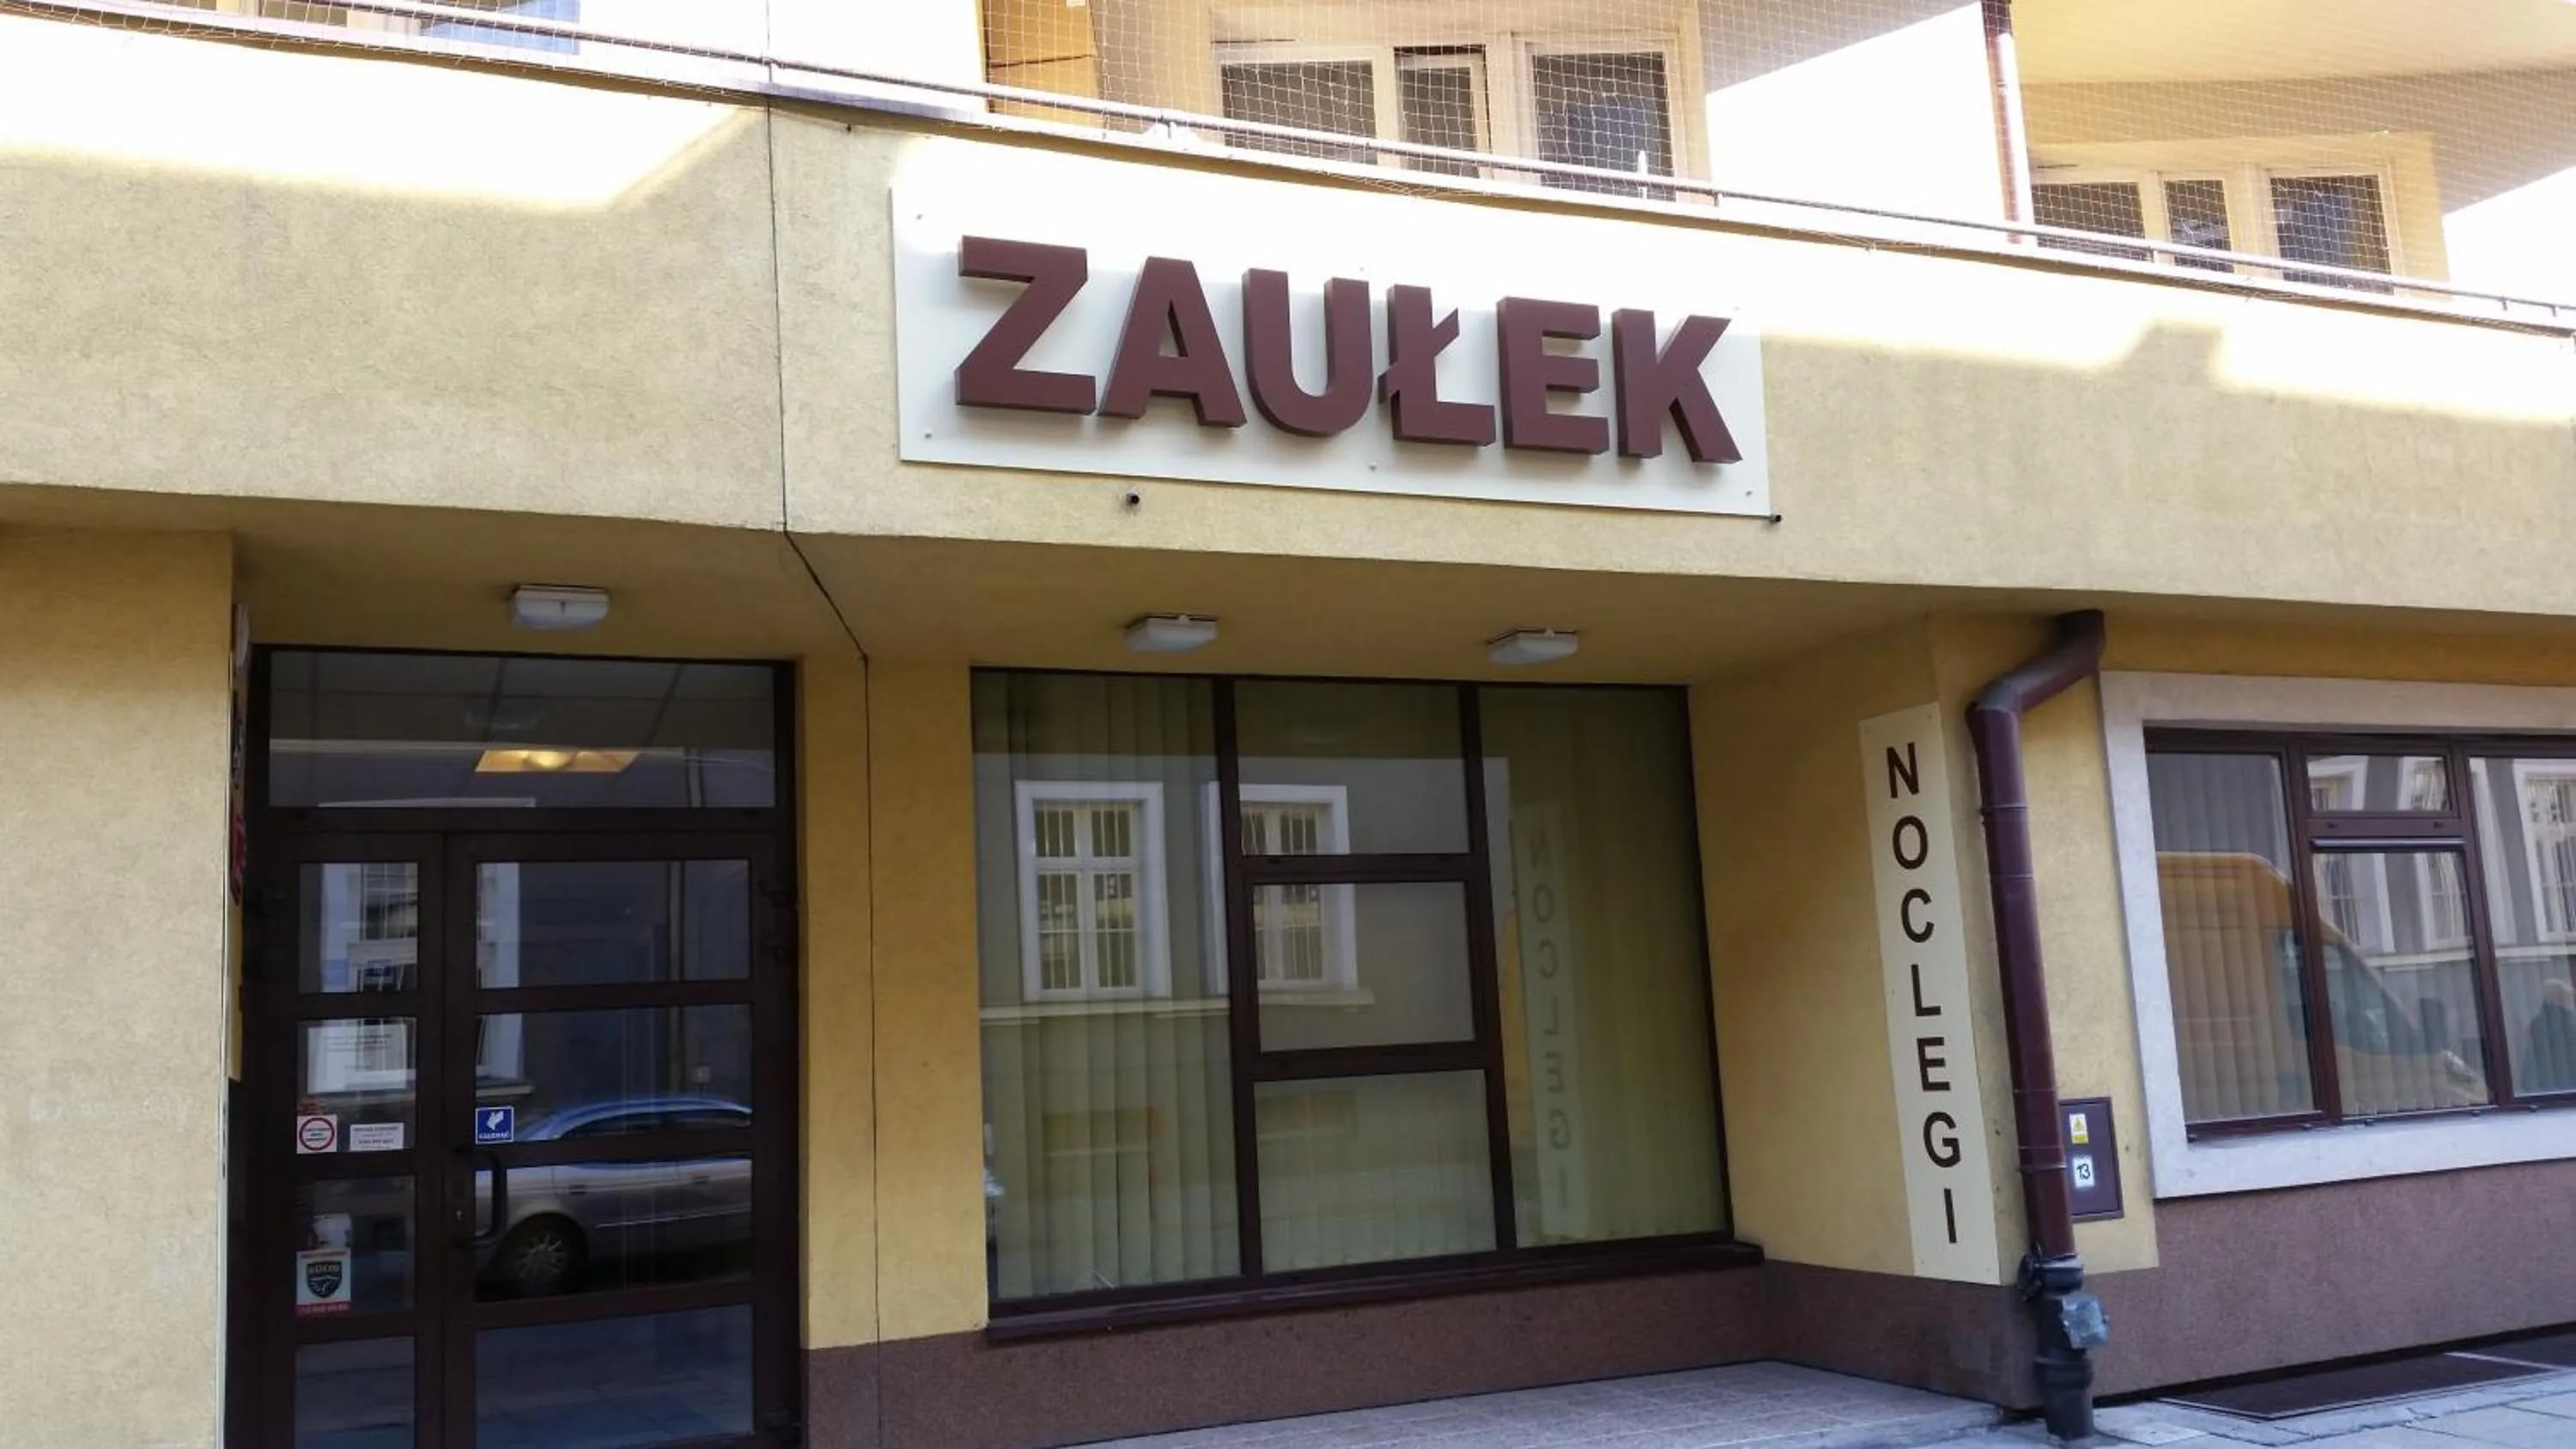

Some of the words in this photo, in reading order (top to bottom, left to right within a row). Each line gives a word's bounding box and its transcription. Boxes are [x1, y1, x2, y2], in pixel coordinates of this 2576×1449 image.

[955, 235, 1742, 464] ZAUŁEK
[1886, 742, 1961, 1243] NOCLEGI
[2076, 1163, 2091, 1179] 13
